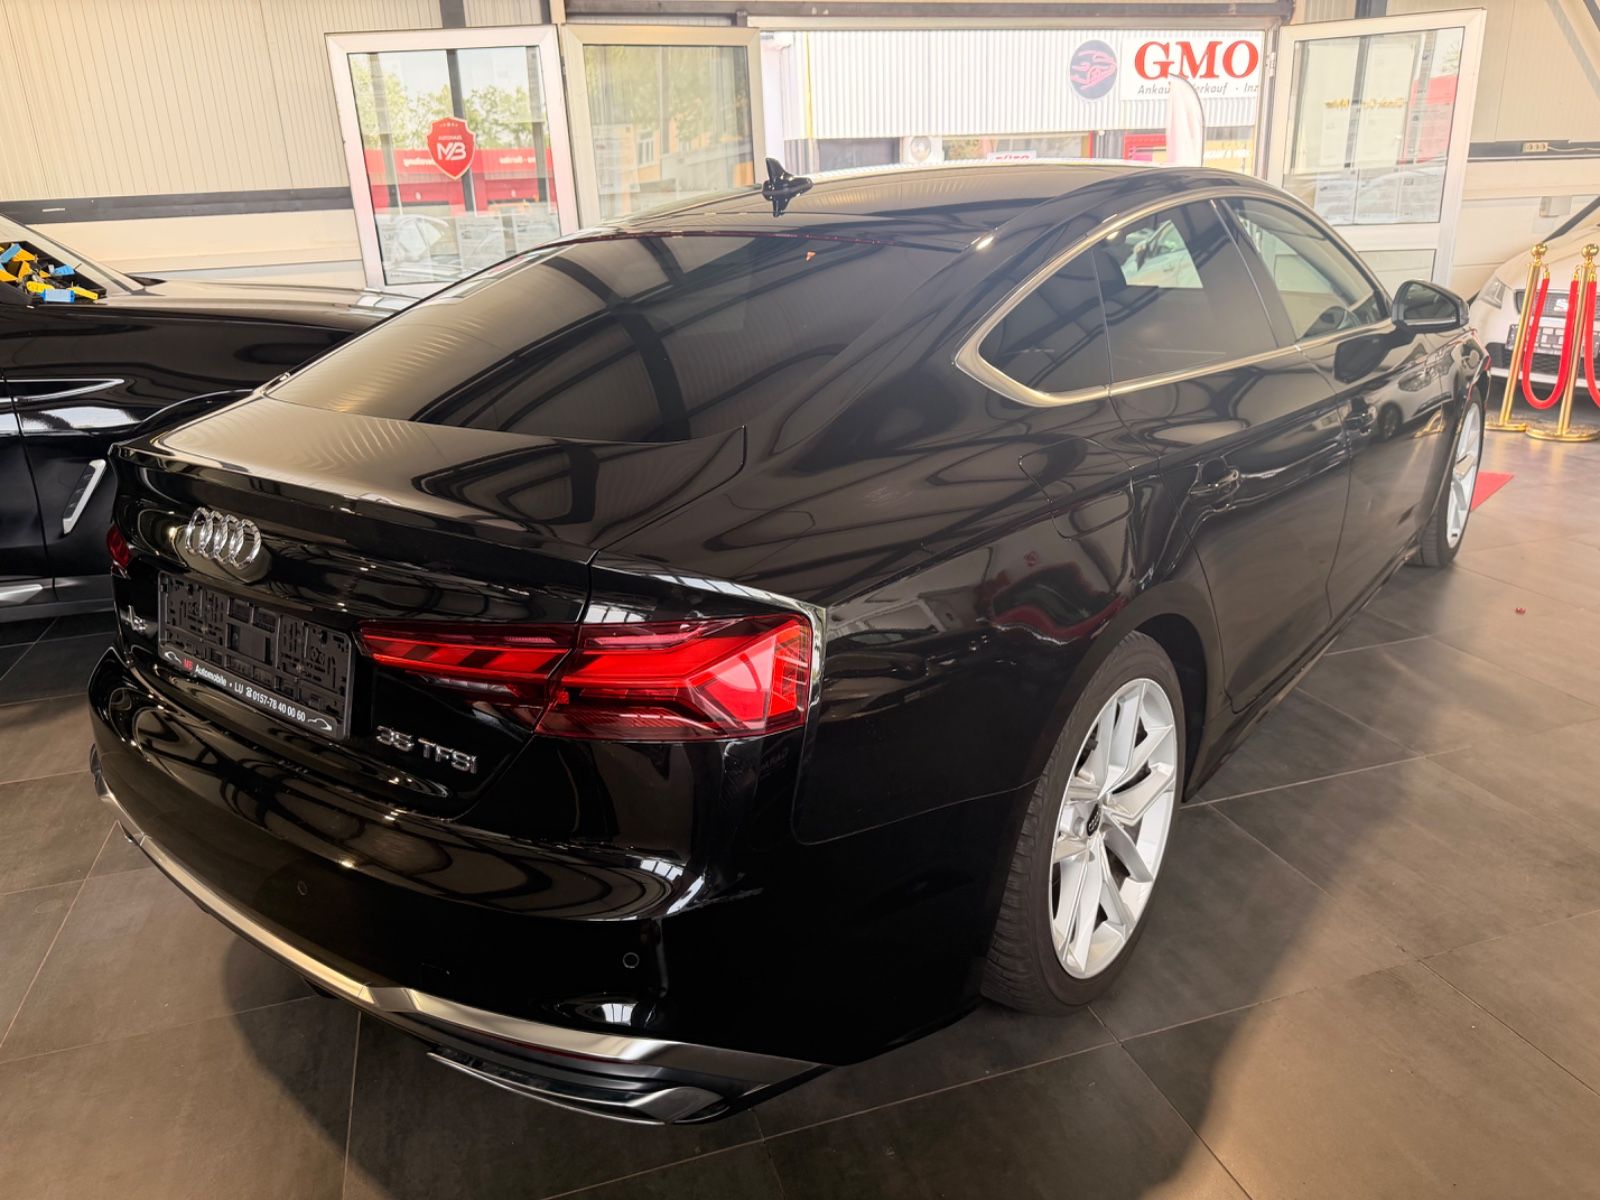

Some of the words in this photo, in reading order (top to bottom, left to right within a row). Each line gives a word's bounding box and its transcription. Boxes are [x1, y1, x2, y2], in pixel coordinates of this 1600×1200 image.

[1135, 40, 1259, 80] GMO
[1137, 82, 1172, 95] Ankau
[436, 141, 467, 161] MB
[194, 663, 227, 687] Automobile
[234, 681, 244, 694] LU
[278, 702, 287, 714] 40
[287, 705, 296, 718] 00
[296, 709, 306, 722] 60
[376, 725, 414, 752] 35
